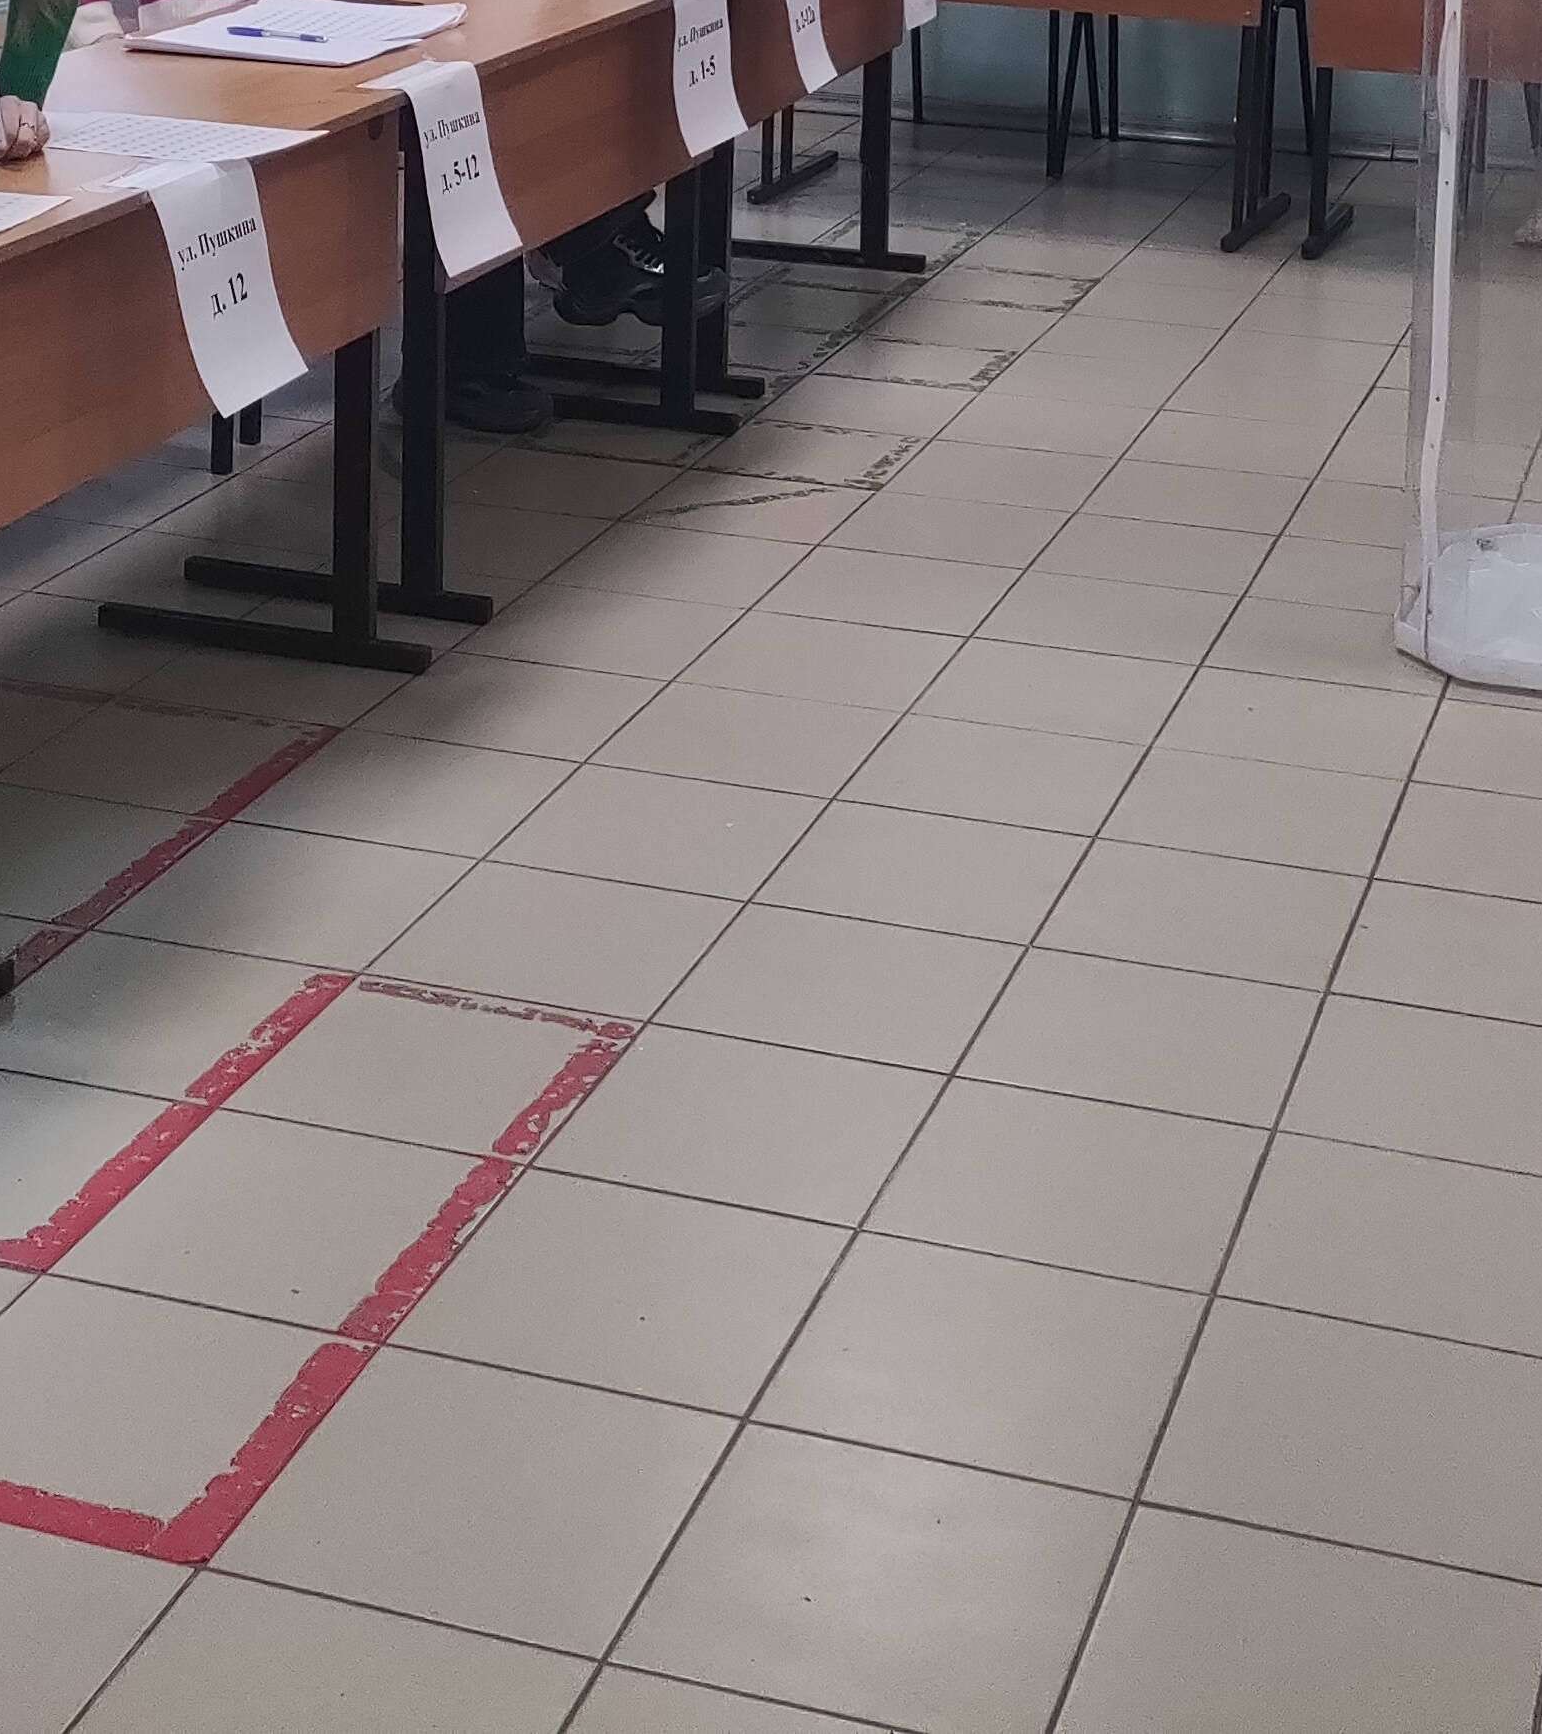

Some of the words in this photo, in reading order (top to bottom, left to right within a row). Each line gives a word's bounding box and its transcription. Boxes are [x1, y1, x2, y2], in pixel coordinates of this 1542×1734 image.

[678, 35, 688, 53] ул.
[690, 18, 724, 44] Пушкина
[689, 70, 698, 87] д.
[700, 55, 716, 80] 1-5
[423, 129, 438, 150] ул.
[437, 111, 481, 141] Пушкина
[441, 173, 453, 195] д.
[453, 154, 480, 186] 5-12
[177, 246, 198, 271] ул.
[198, 217, 257, 257] Пушкина
[210, 292, 227, 320] д.
[228, 272, 248, 305] 12
